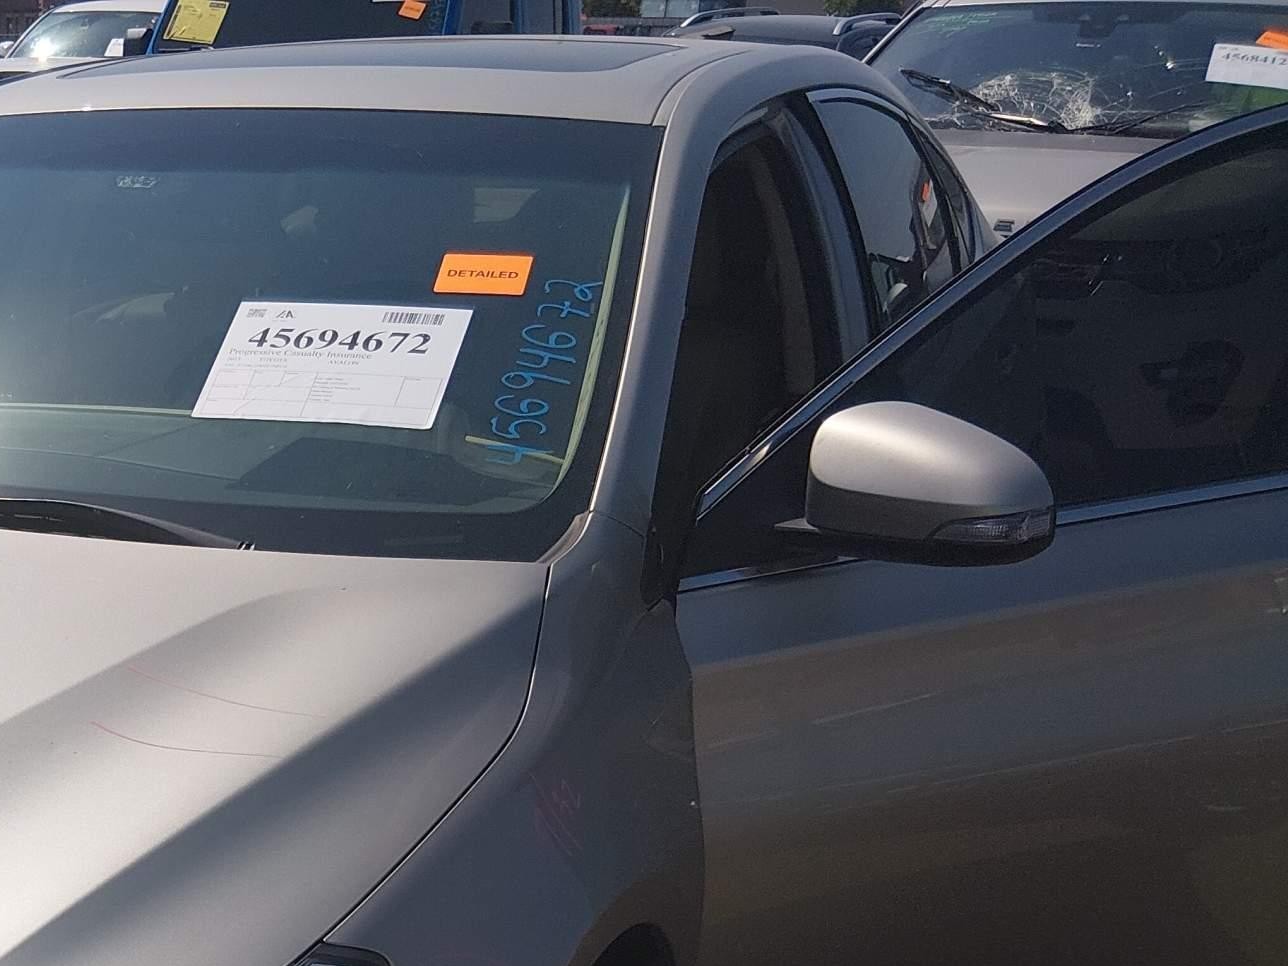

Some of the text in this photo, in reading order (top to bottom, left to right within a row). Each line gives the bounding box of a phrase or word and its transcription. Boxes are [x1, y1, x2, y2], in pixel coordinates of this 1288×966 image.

[447, 269, 519, 280] DETAILED
[248, 327, 432, 355] 45694672
[229, 348, 373, 360] Progressive Casualty Insurance
[486, 279, 604, 465] 45694672
